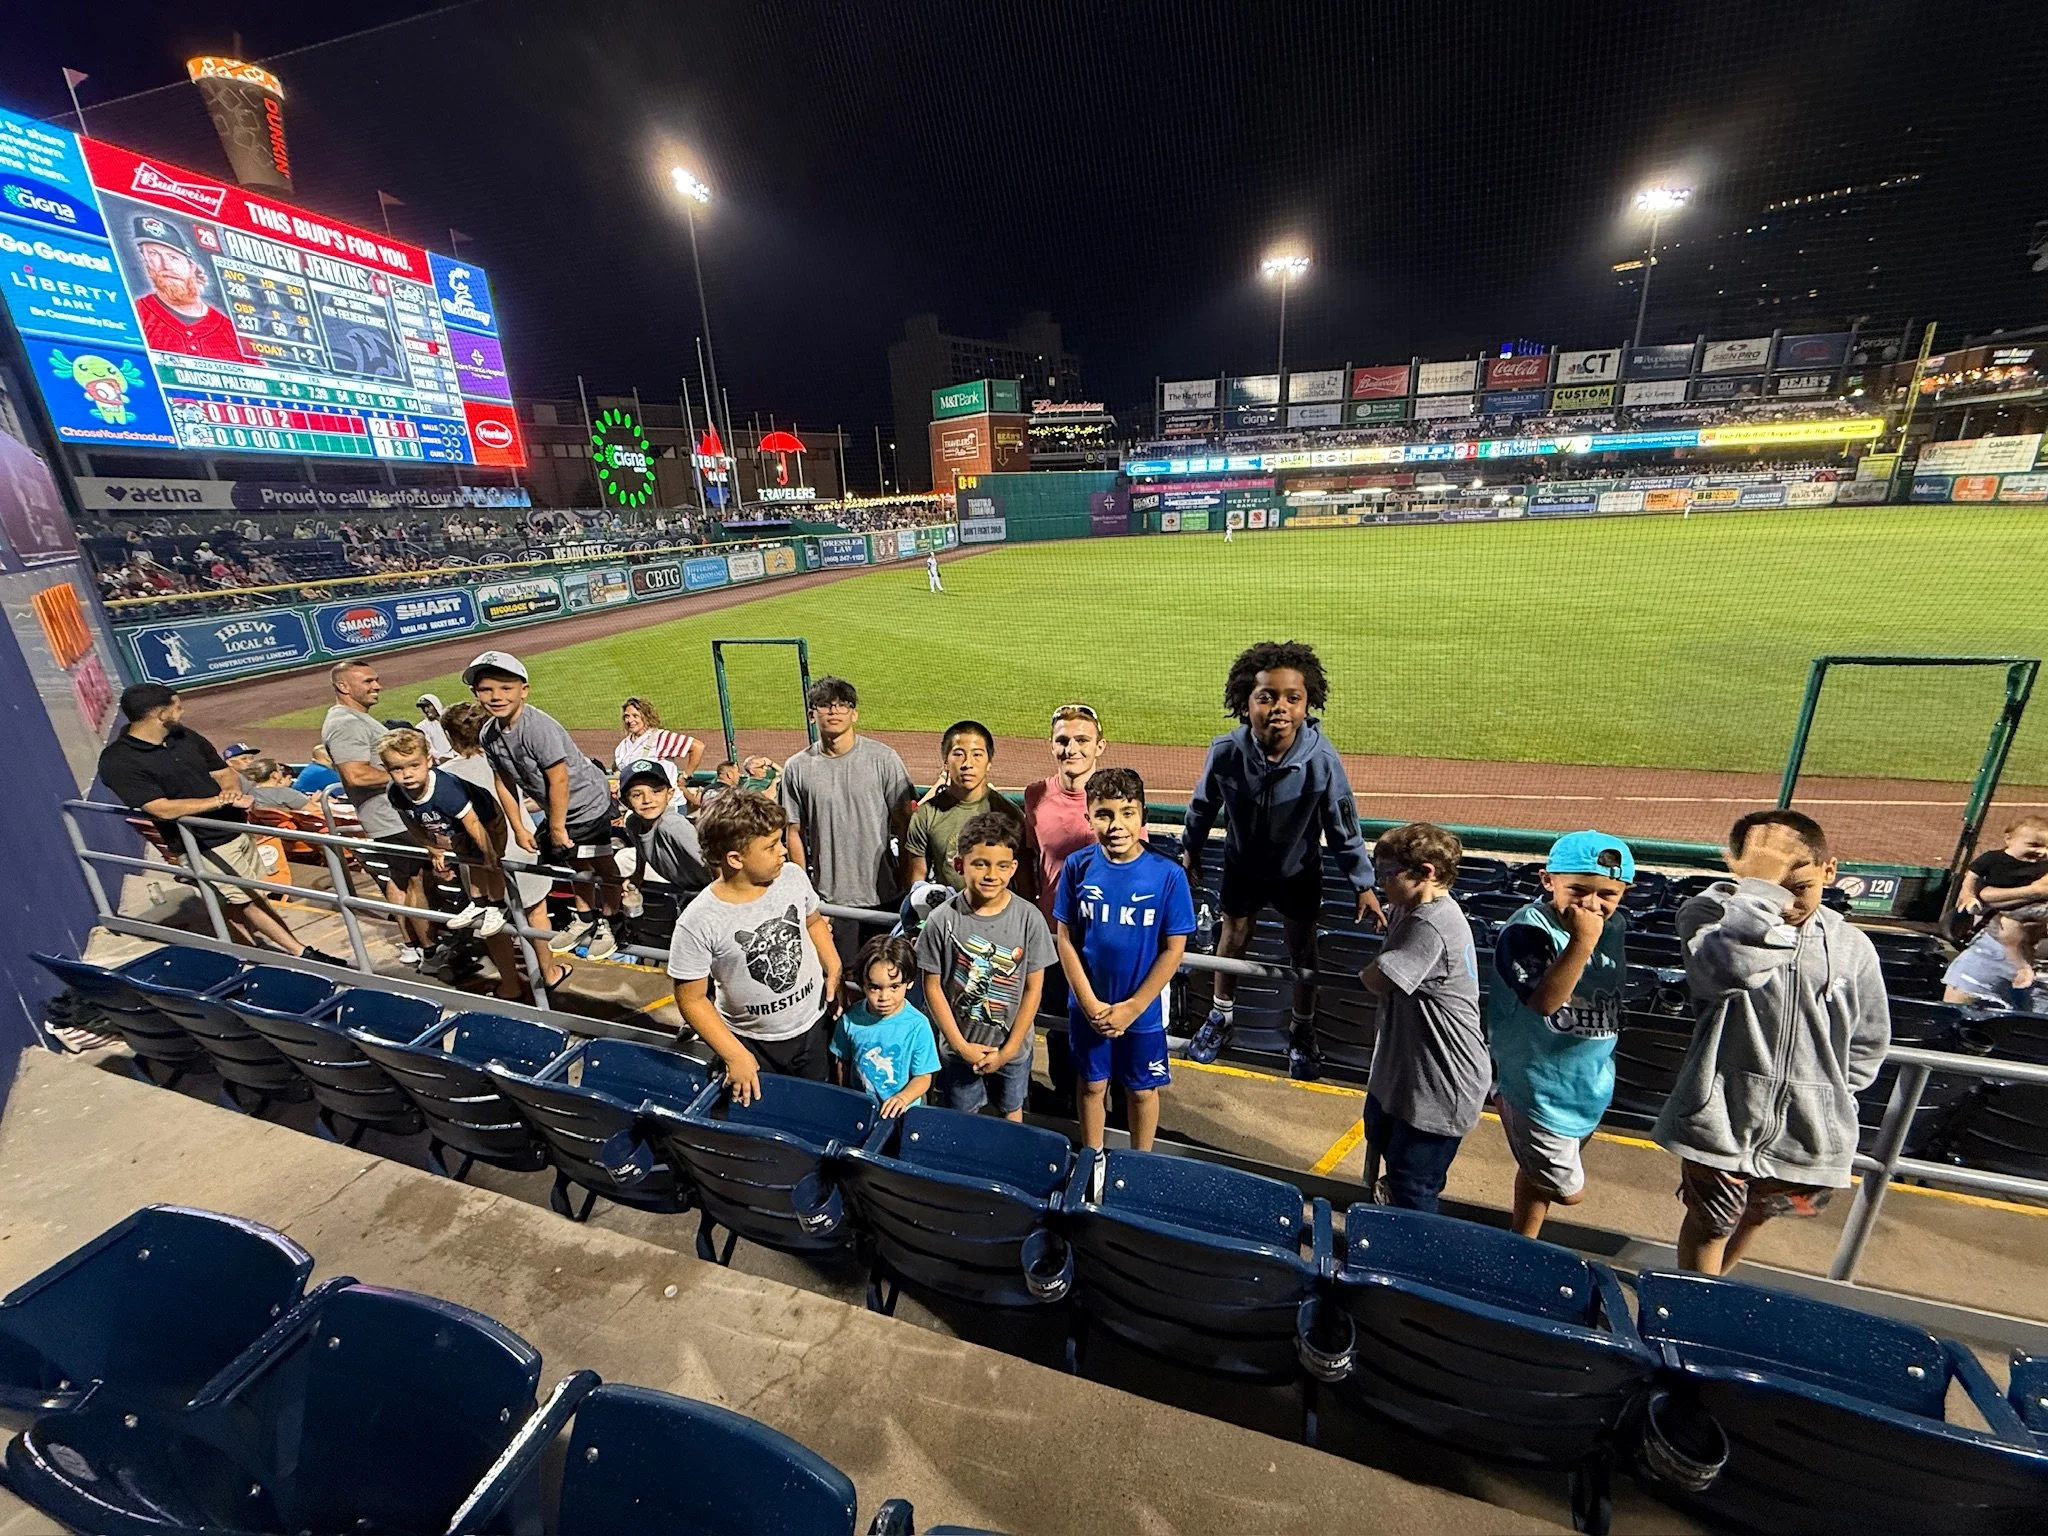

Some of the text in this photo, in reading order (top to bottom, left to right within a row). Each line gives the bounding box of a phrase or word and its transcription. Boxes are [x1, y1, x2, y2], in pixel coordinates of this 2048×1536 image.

[134, 167, 219, 206] Budweiser
[244, 200, 413, 272] THIS BUD'S FOR YOU.
[197, 228, 217, 248] 26
[225, 230, 303, 275] ANDREW
[304, 253, 370, 292] JENKINS
[11, 271, 117, 303] LIBERTY
[224, 269, 246, 282] AVG
[261, 278, 276, 290] HR
[51, 295, 95, 312] BANK
[264, 289, 279, 305] 10
[249, 341, 317, 364] TODAY: 1-2
[1738, 351, 1760, 360] PRO
[1492, 359, 1540, 378] Coca-Cola
[1582, 353, 1611, 374] CT
[221, 376, 269, 394] PALERMO
[279, 382, 300, 397] 3-4
[1420, 376, 1463, 385] TRAVELERS
[206, 393, 213, 401] 1
[224, 395, 232, 403] 2
[242, 397, 250, 405] 3
[261, 399, 268, 407] 4
[276, 401, 283, 409] 5
[940, 390, 979, 410] M&T Bank
[1182, 391, 1212, 400] Hartford
[1556, 388, 1610, 400] CUSTOM
[1032, 398, 1104, 413] Budweiser
[207, 403, 415, 438] 0 0 0 0 2 2 5 0
[60, 426, 175, 444] ChooseYourSchool.org
[215, 427, 419, 457] 0 0 0 0 1 1 3 0
[479, 427, 508, 440] Henkel
[130, 484, 203, 503] aetna
[261, 488, 315, 504] Proud
[319, 490, 337, 504] to
[338, 490, 368, 505] call
[369, 489, 430, 507] Hartford
[431, 493, 452, 504] our
[757, 487, 816, 501] TRAVELERS
[1460, 487, 1509, 497] Groundworks
[1133, 494, 1160, 511] HOOKER
[822, 538, 864, 548] DRESSLER
[834, 545, 853, 554] LAW
[645, 568, 680, 589] CBTG
[686, 564, 718, 576] JEFFERSON
[395, 597, 462, 620] SMART
[214, 621, 276, 643] IBEW
[338, 615, 387, 633] SMACNA
[224, 635, 276, 654] LOCAL 42
[208, 649, 298, 670] CONSTRUCTION LINEMEN
[1869, 879, 1894, 894] 120
[1080, 900, 1156, 927] NIKE
